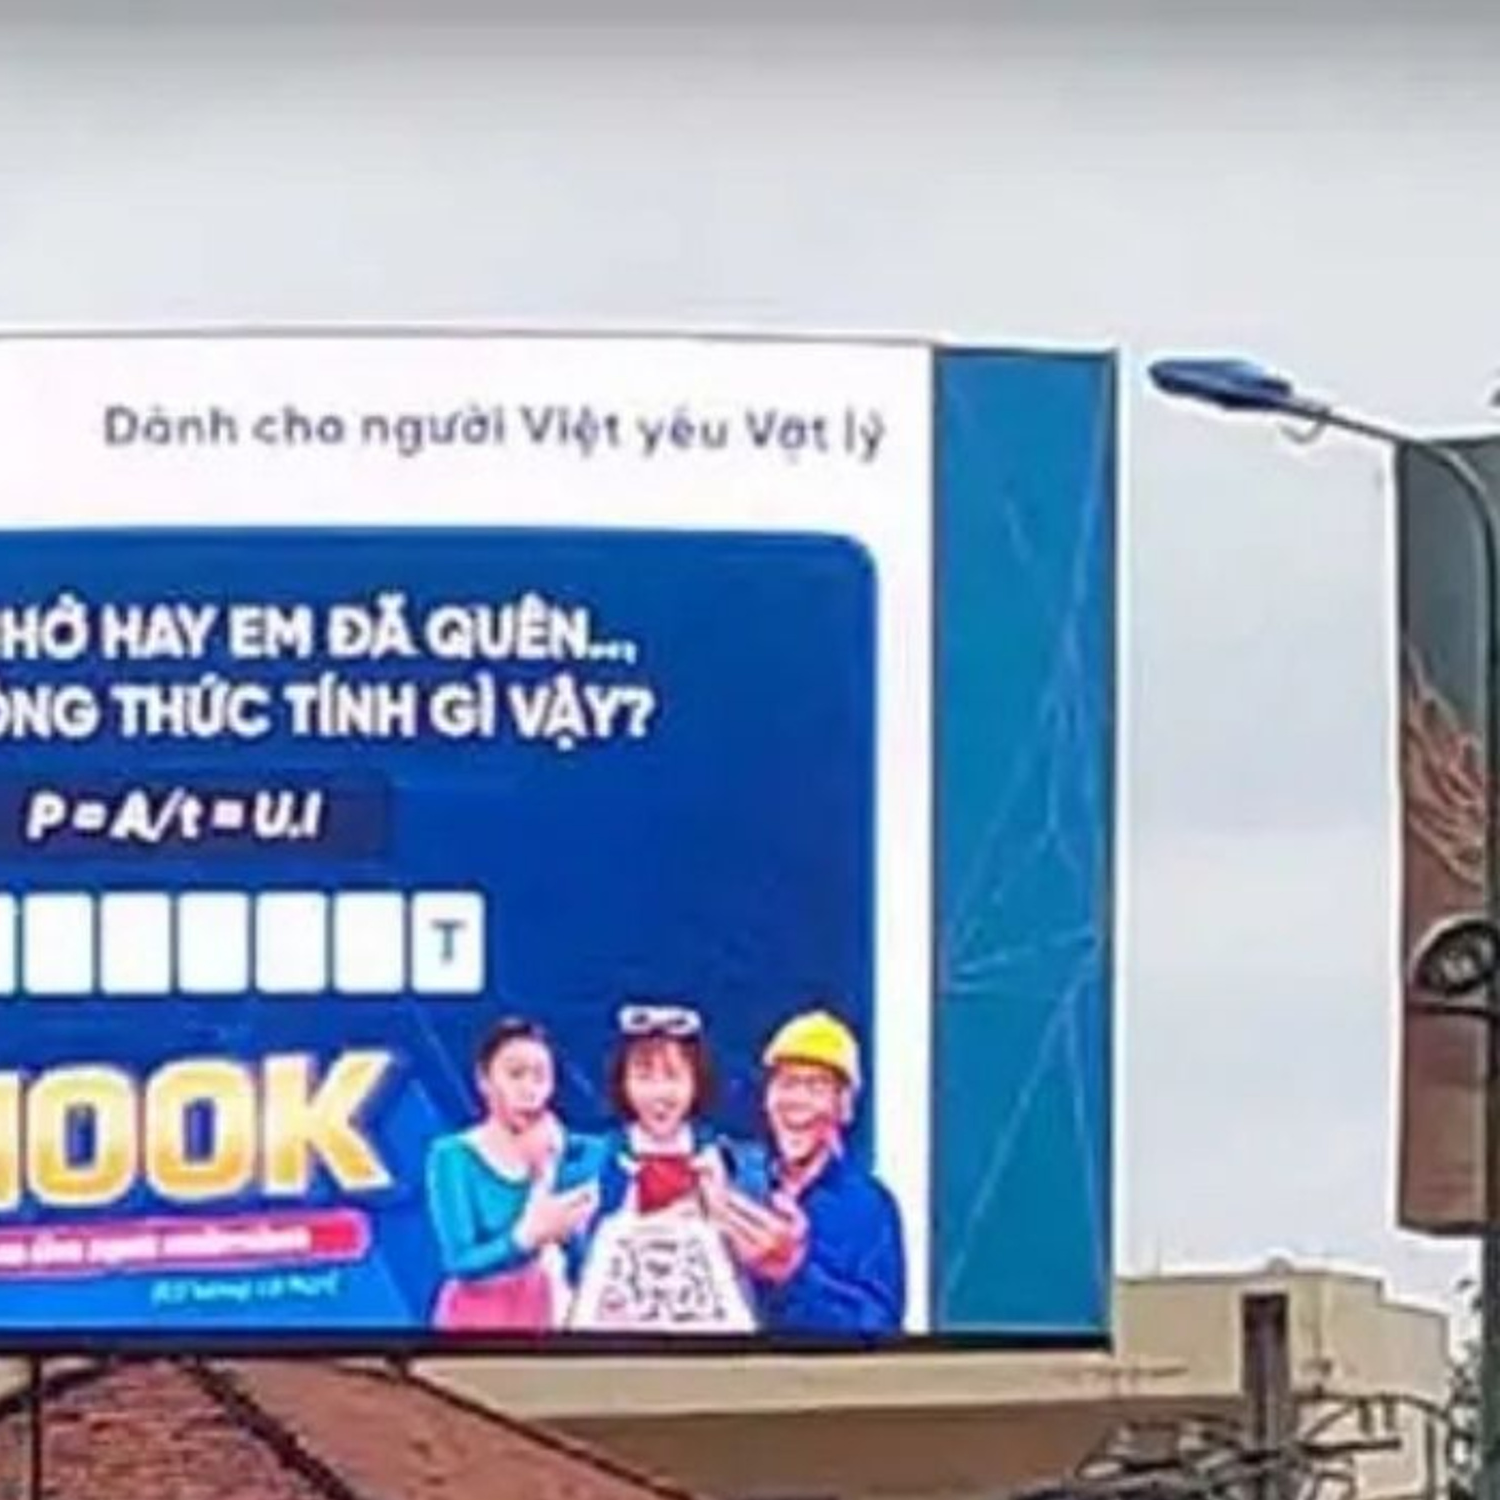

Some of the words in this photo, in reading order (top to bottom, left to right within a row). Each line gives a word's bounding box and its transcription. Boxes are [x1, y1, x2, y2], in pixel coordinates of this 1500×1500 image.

[251, 405, 347, 446] cho
[103, 602, 218, 660] HAY
[230, 605, 315, 660] EM
[328, 592, 418, 660] ĐÃ
[110, 673, 270, 737] THỨC
[284, 672, 418, 738] TÍNH
[429, 672, 496, 738] GÌ
[26, 791, 66, 840] P
[109, 786, 203, 842] A/t
[430, 919, 468, 964] T
